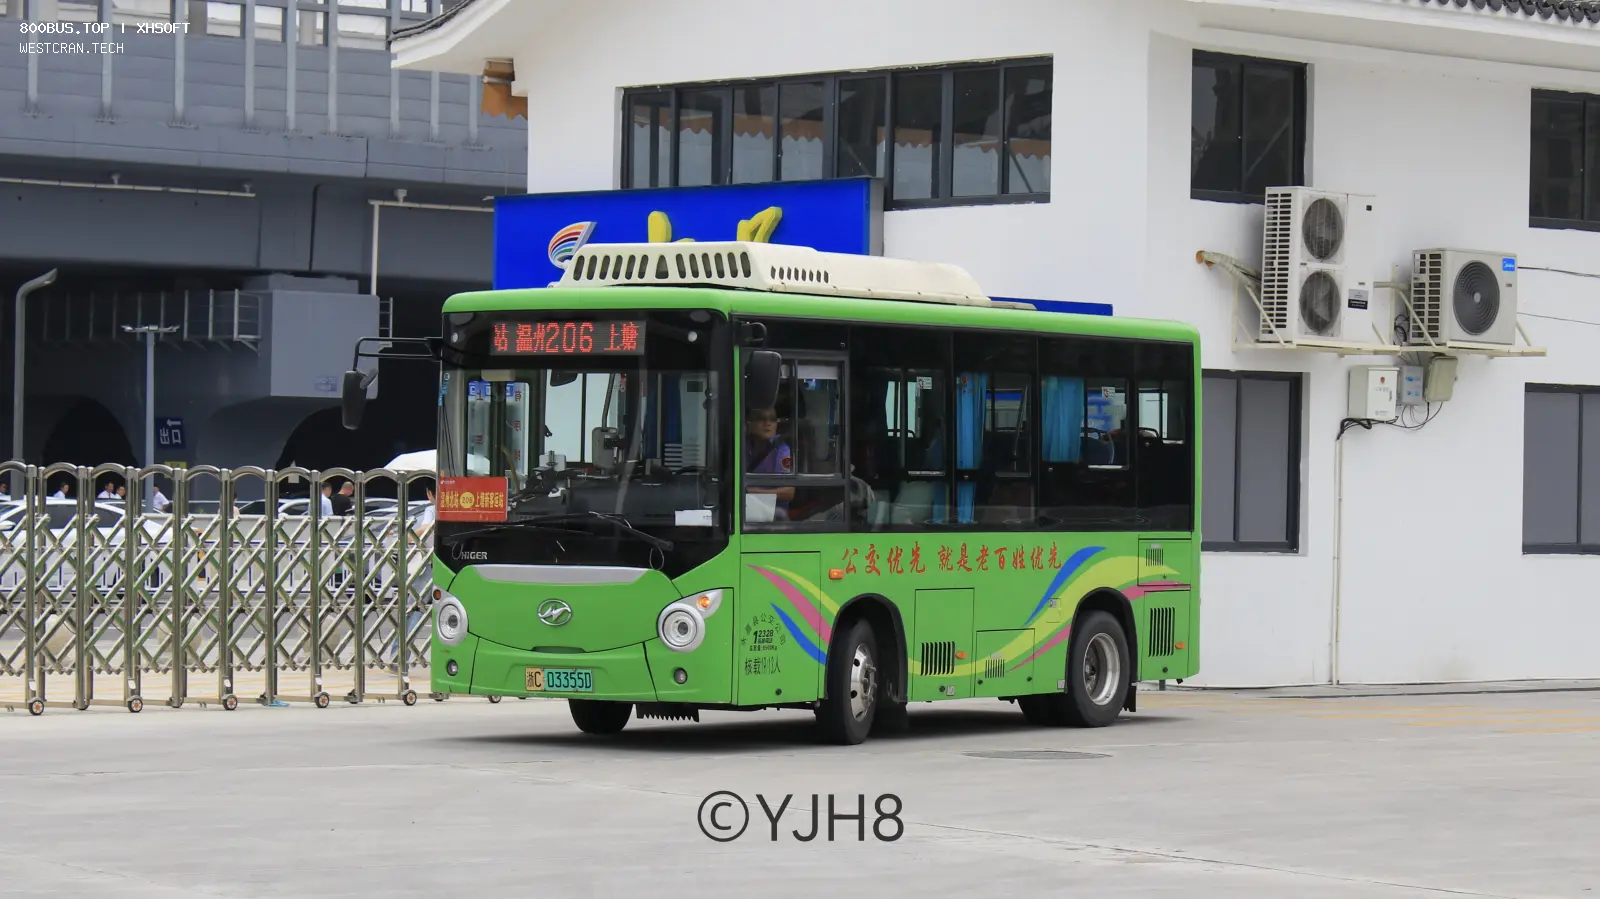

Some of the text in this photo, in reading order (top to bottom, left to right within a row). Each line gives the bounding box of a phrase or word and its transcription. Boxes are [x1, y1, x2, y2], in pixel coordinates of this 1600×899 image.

[604, 322, 640, 351] 上塘
[159, 428, 182, 445] 出口
[842, 541, 1063, 576] 公交优先 就是老百姓优先
[547, 672, 592, 688] 03355D
